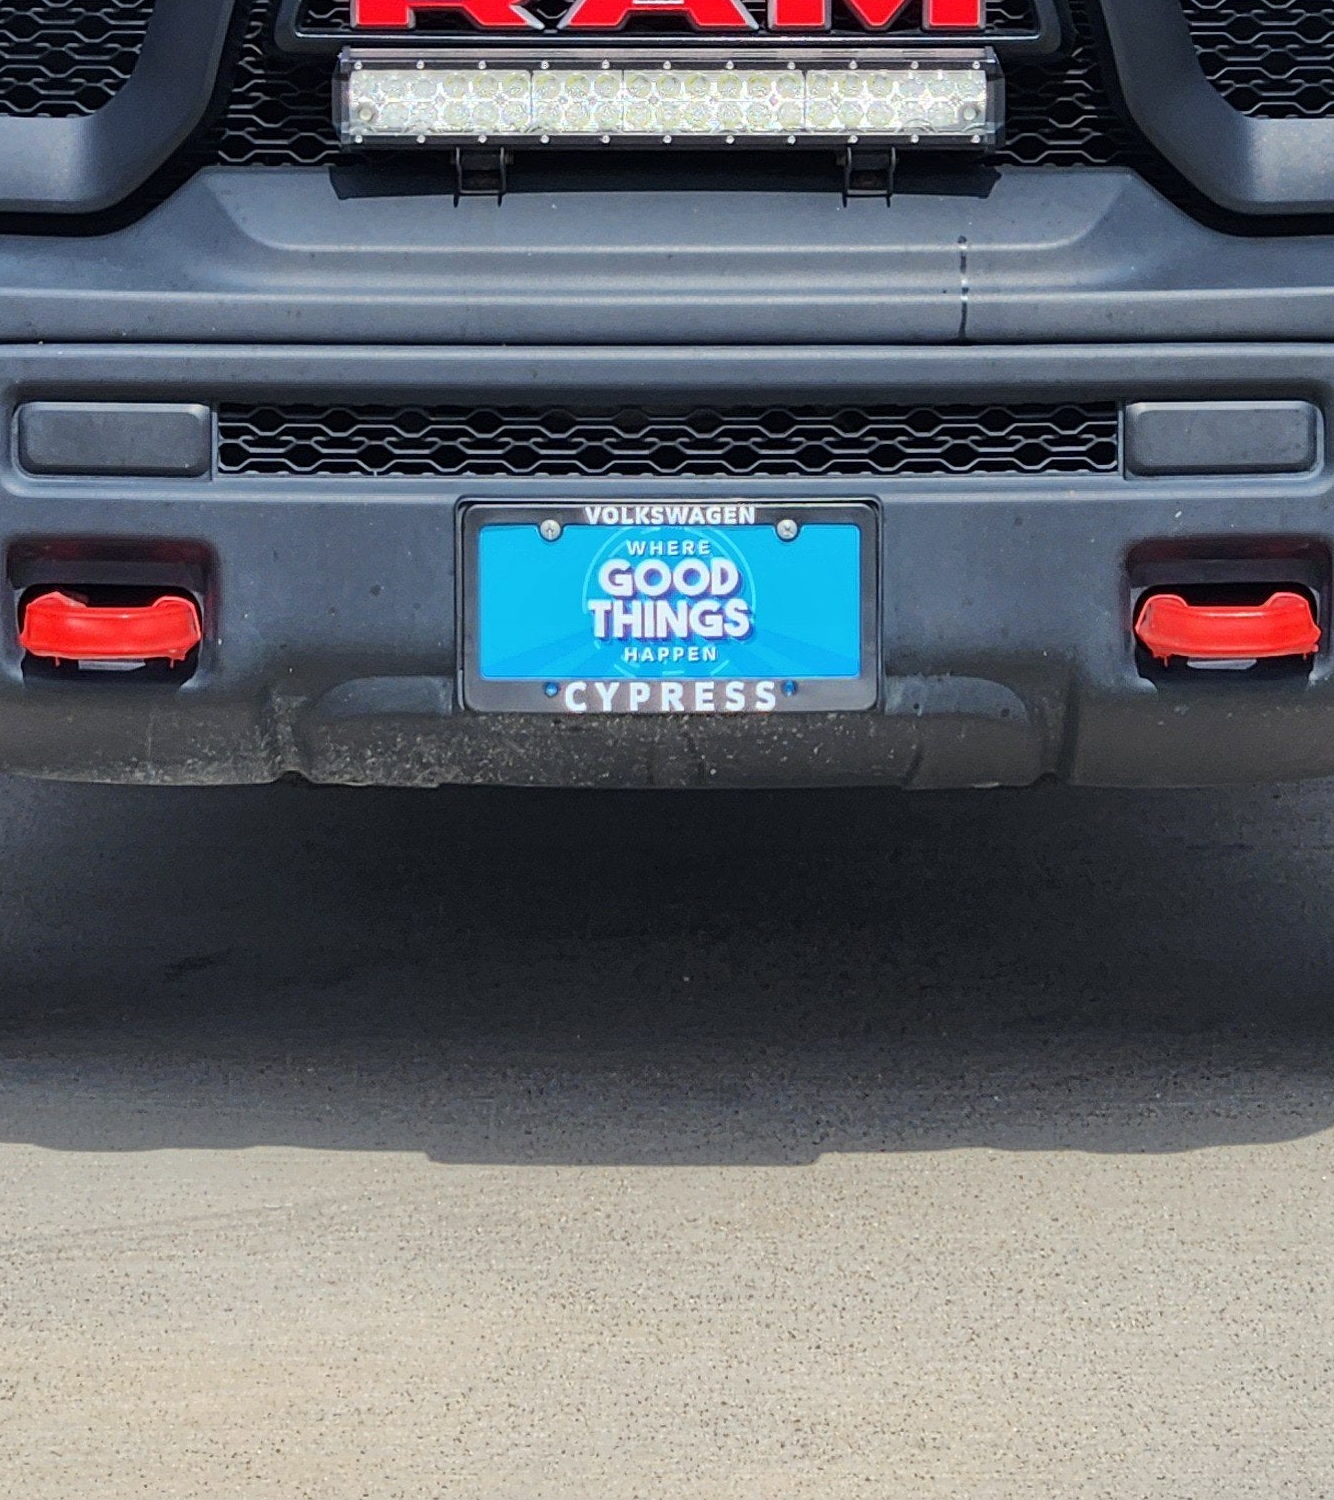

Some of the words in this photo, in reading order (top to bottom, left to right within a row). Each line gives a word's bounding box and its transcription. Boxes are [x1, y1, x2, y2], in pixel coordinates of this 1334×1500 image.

[584, 506, 756, 525] VOLKSWAGEN
[626, 540, 711, 556] WHERE
[598, 558, 741, 597] GOOD
[588, 598, 752, 639] THINGS
[624, 646, 718, 662] HAPPEN
[564, 681, 777, 712] CYPRESS
